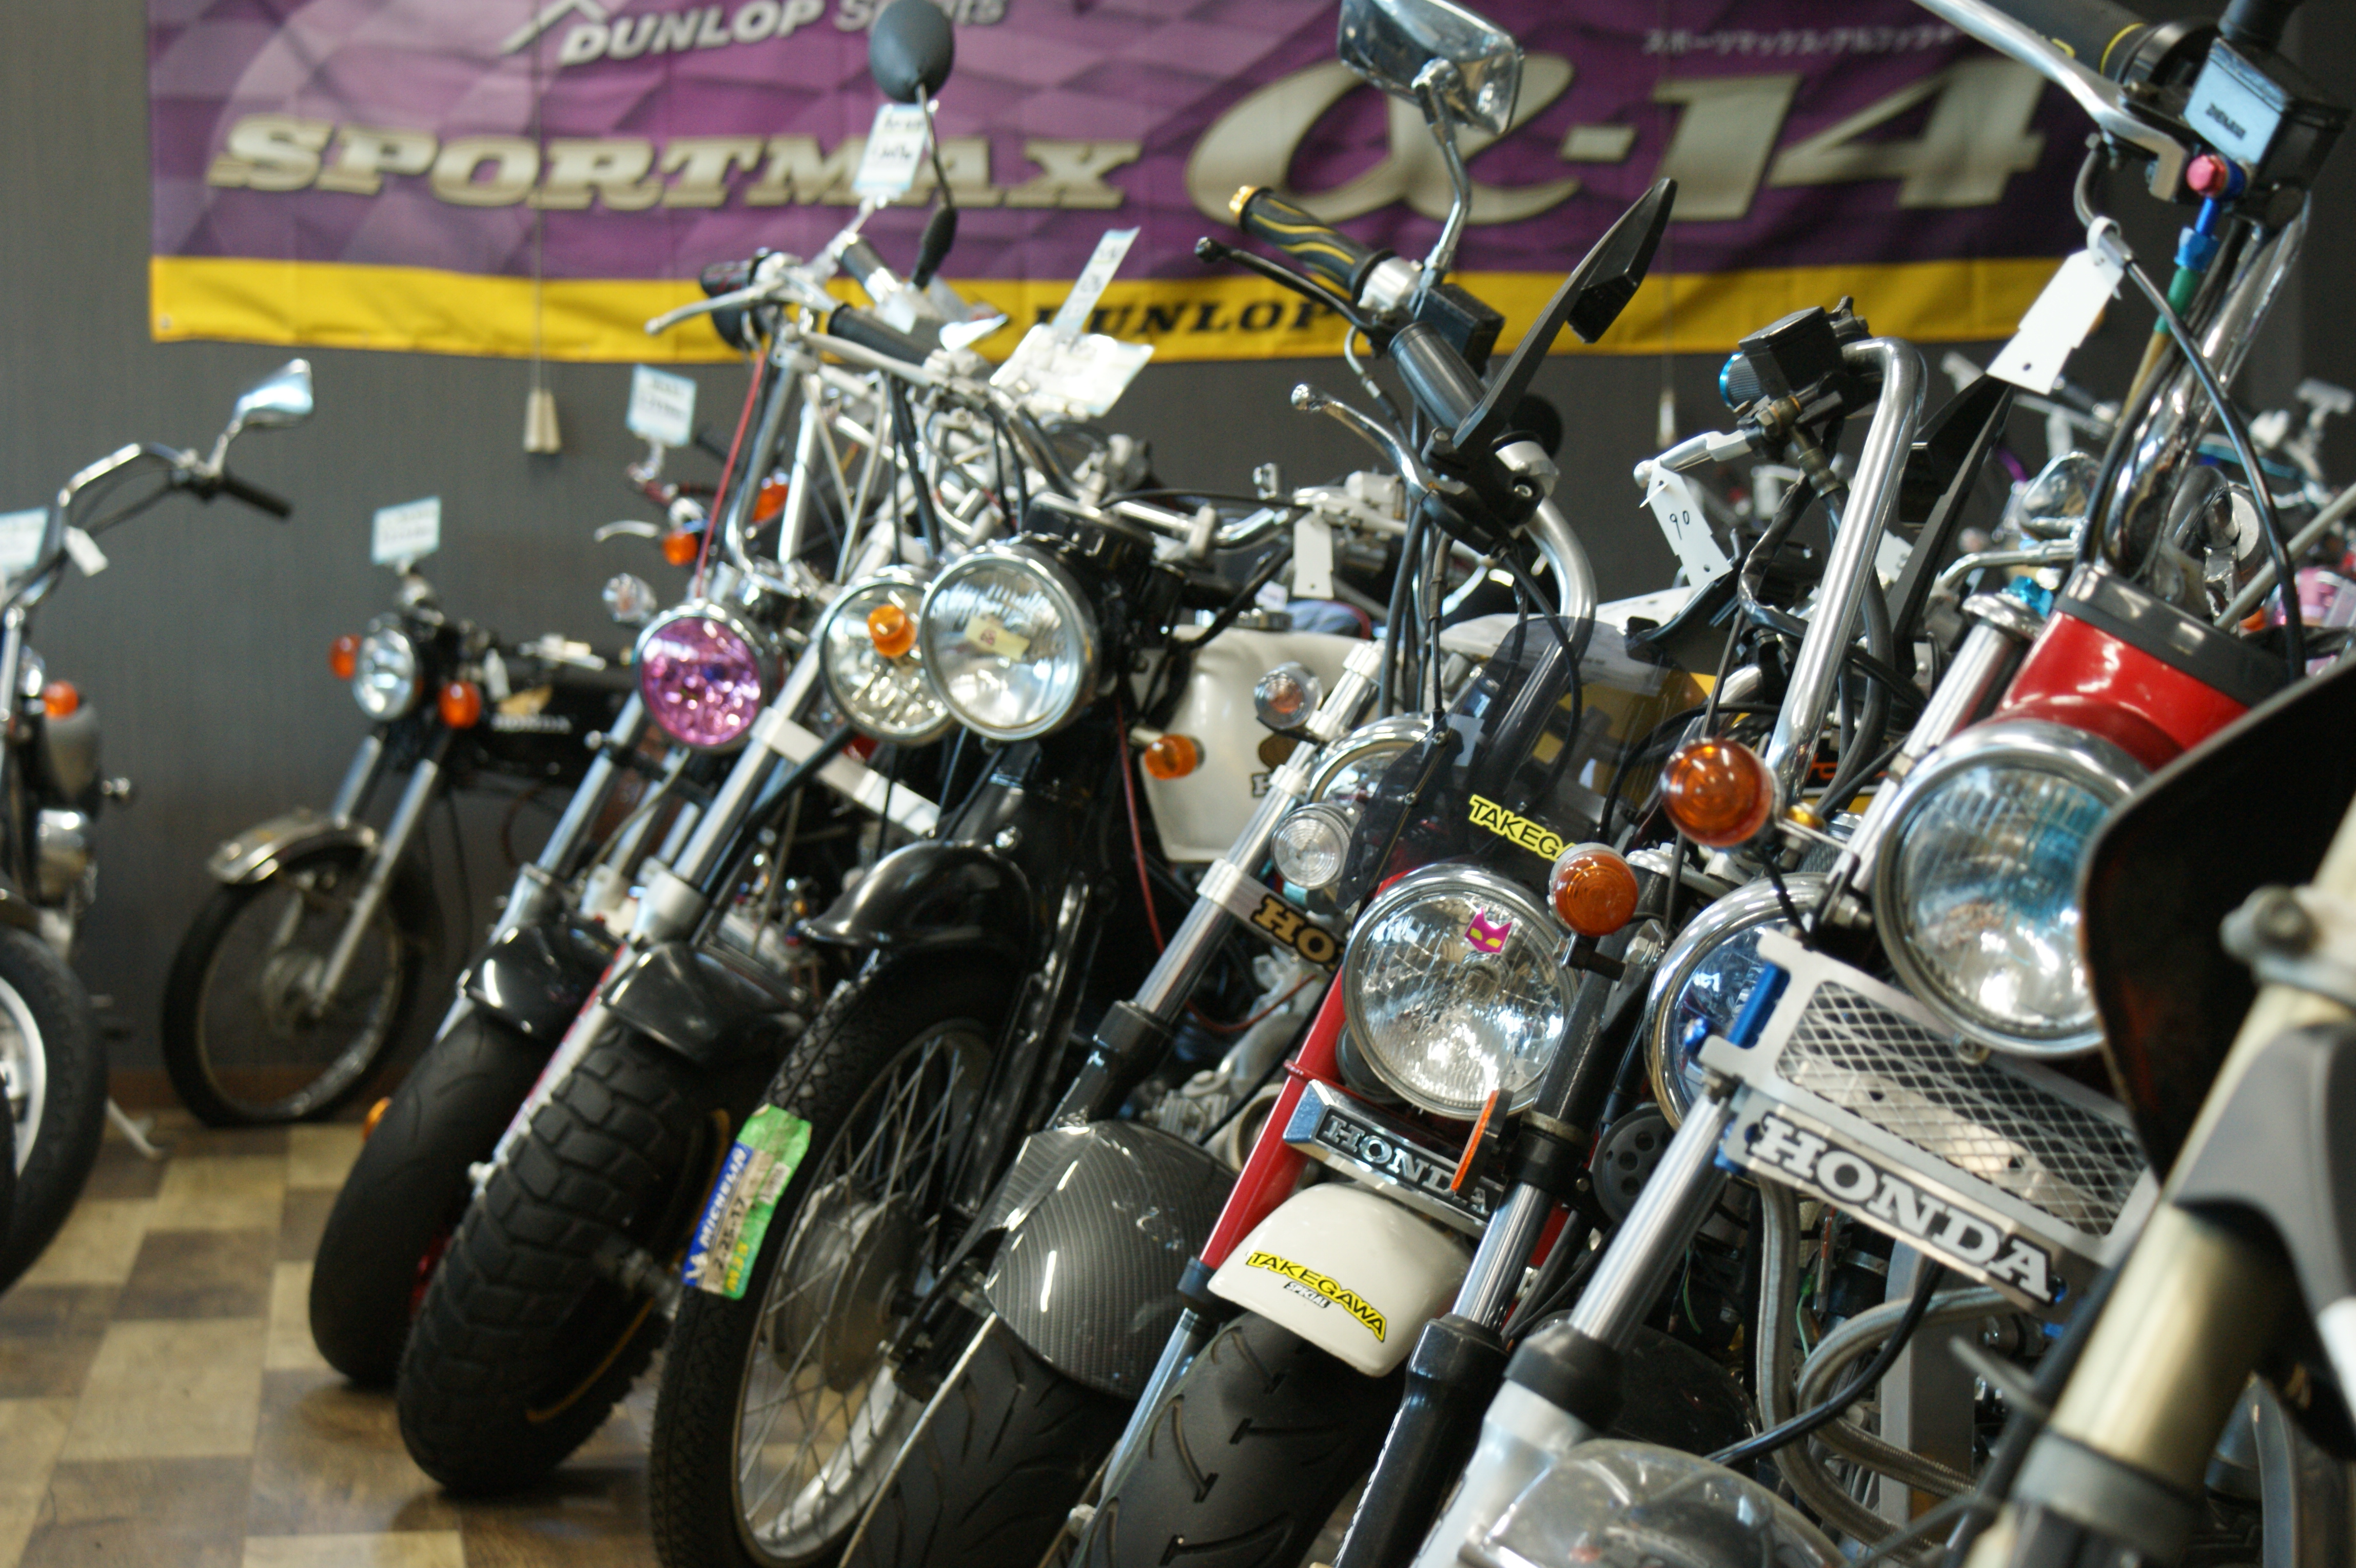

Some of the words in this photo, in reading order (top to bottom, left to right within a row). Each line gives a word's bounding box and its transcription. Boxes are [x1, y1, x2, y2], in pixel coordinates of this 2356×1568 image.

[559, 0, 822, 66] DUNLOP
[208, 115, 1142, 210] SPORTMAX
[1669, 510, 1690, 540] 90
[1474, 798, 1568, 857] TAKEG
[1252, 894, 1345, 972] HO
[699, 1147, 747, 1248] MICHELIN
[1750, 1115, 2052, 1302] HONDA
[1253, 1252, 1383, 1336] TAKEGAWA
[1286, 1281, 1328, 1307] SPECIAL
